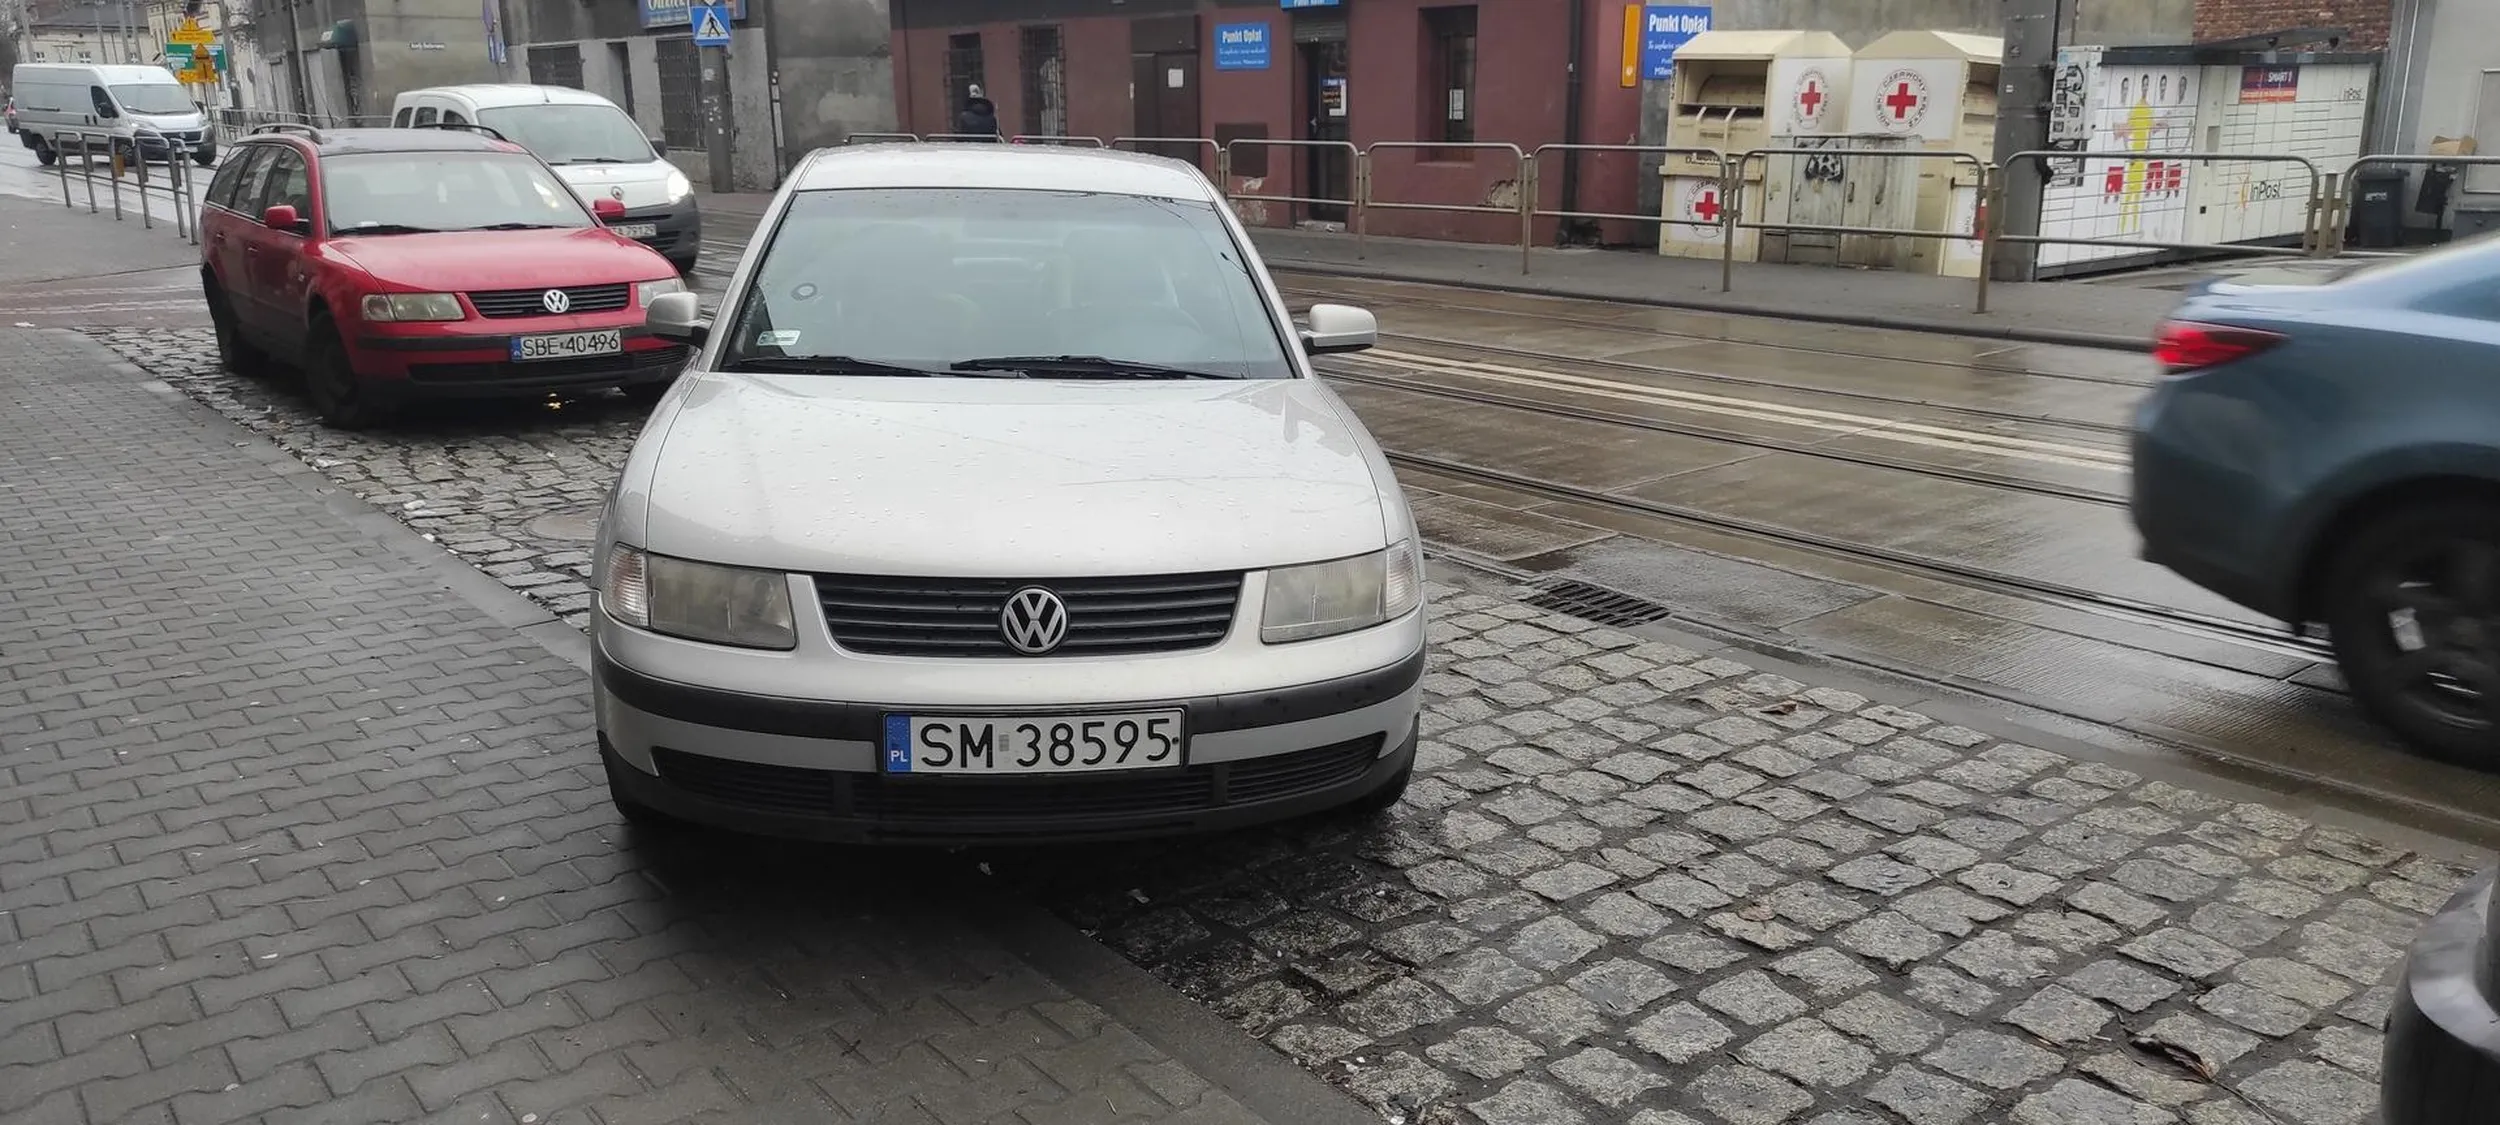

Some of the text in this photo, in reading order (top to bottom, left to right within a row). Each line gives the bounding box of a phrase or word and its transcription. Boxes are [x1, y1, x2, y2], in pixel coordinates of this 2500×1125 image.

[1649, 13, 1679, 32] Punkt
[2249, 180, 2281, 201] InPost
[522, 332, 619, 357] SBE 40496
[920, 717, 1172, 768] SM 38595
[890, 750, 908, 762] PL
